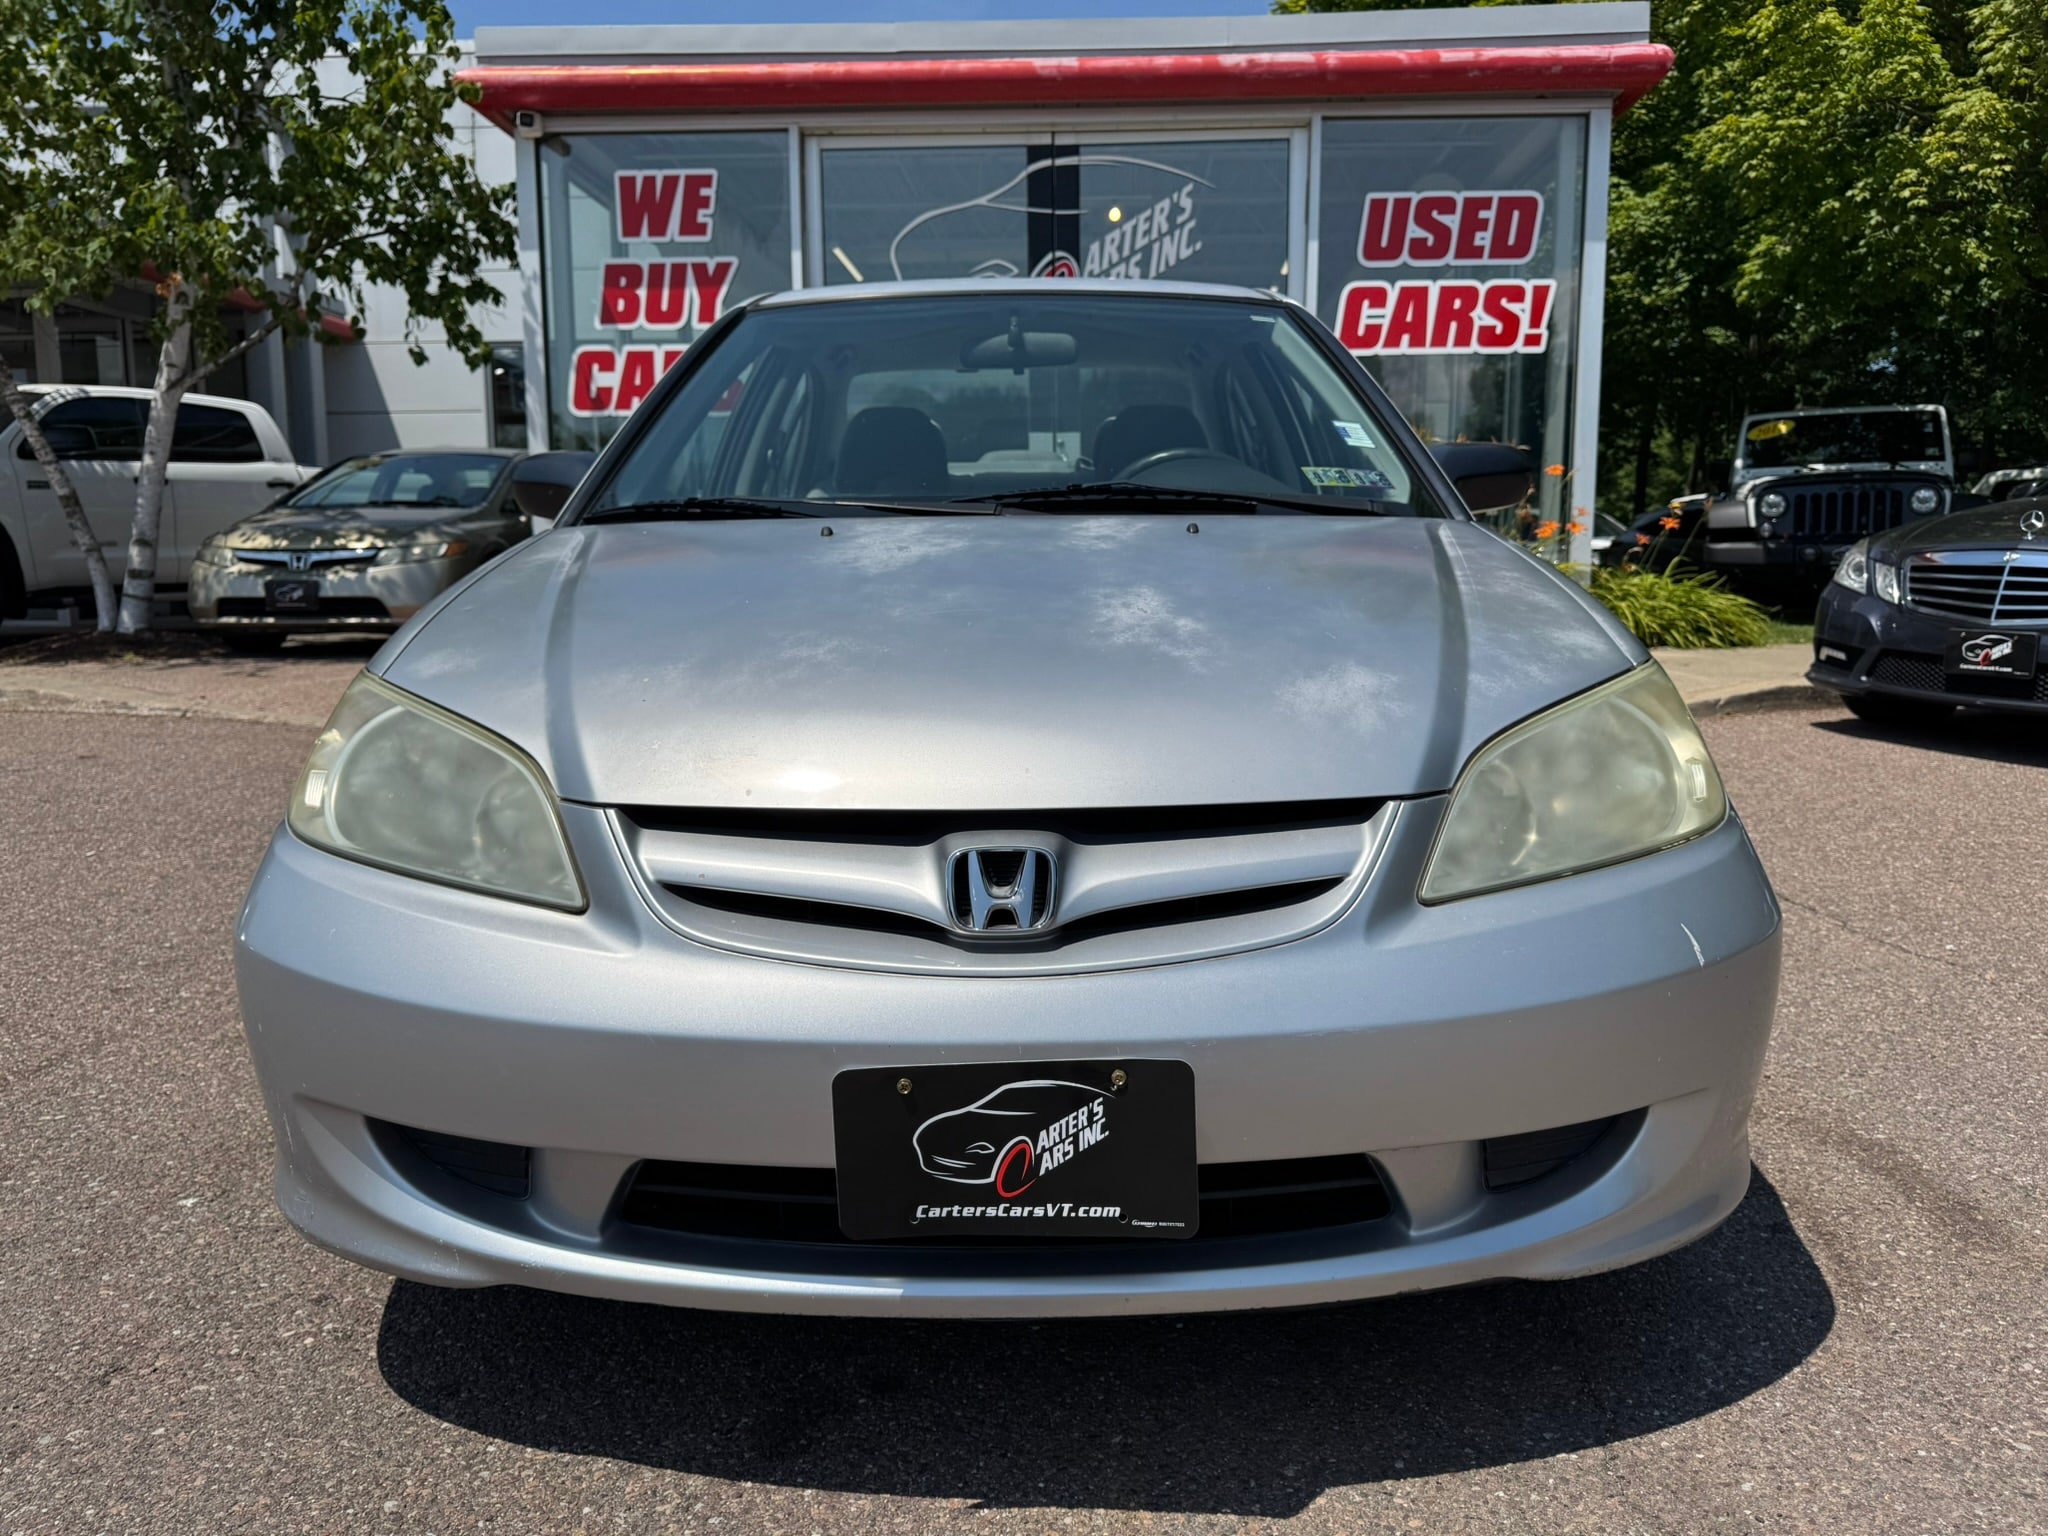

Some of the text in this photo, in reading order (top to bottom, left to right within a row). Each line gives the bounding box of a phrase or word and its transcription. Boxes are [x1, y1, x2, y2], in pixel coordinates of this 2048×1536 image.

[616, 170, 716, 240] WE
[1358, 192, 1542, 266] USED
[596, 258, 738, 328] BUY
[1336, 280, 1556, 355] CARS!
[1079, 1117, 1110, 1152] INC.
[916, 1203, 1121, 1218] CartersCarsVT.com
